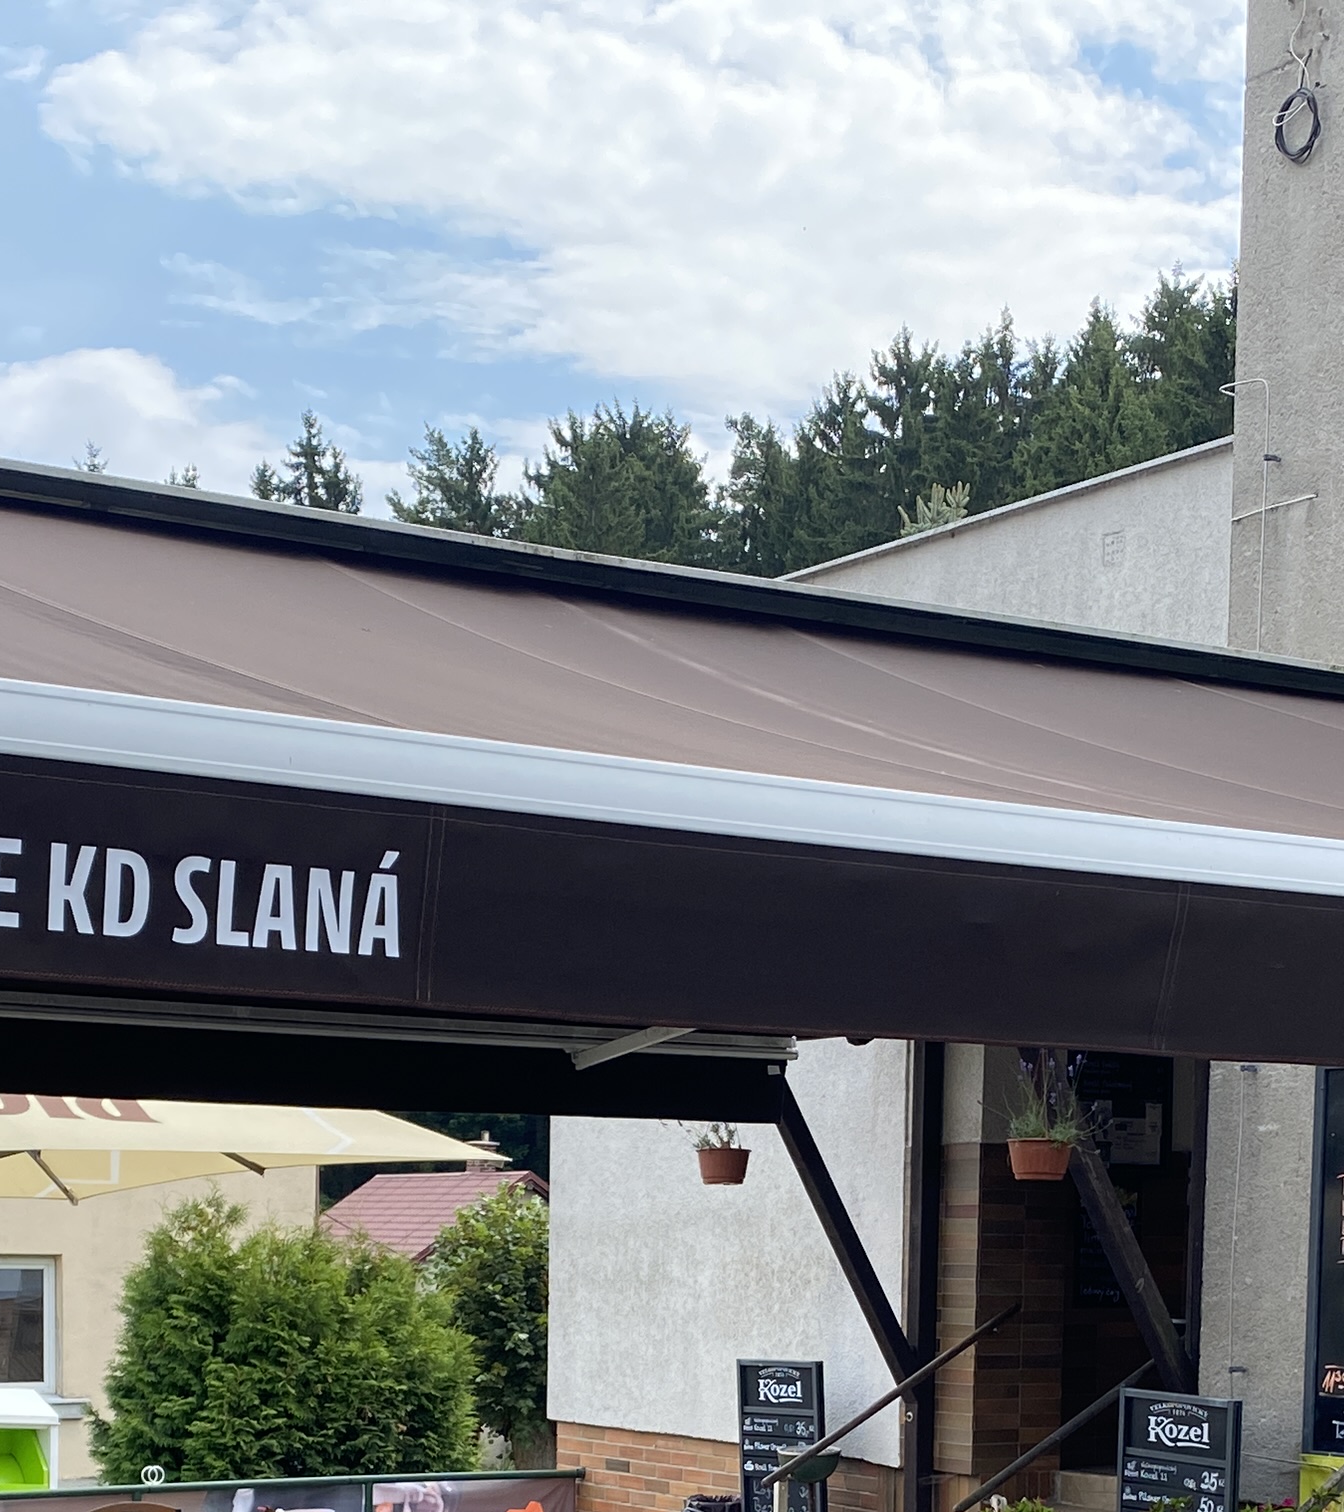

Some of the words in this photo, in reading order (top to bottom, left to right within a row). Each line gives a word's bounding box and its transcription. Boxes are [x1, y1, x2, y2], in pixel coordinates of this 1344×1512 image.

[47, 843, 151, 939] KD
[172, 850, 401, 958] SLANÁ
[757, 1379, 803, 1403] Kozel
[1147, 1415, 1210, 1449] Kozel
[1200, 1471, 1219, 1491] 35
